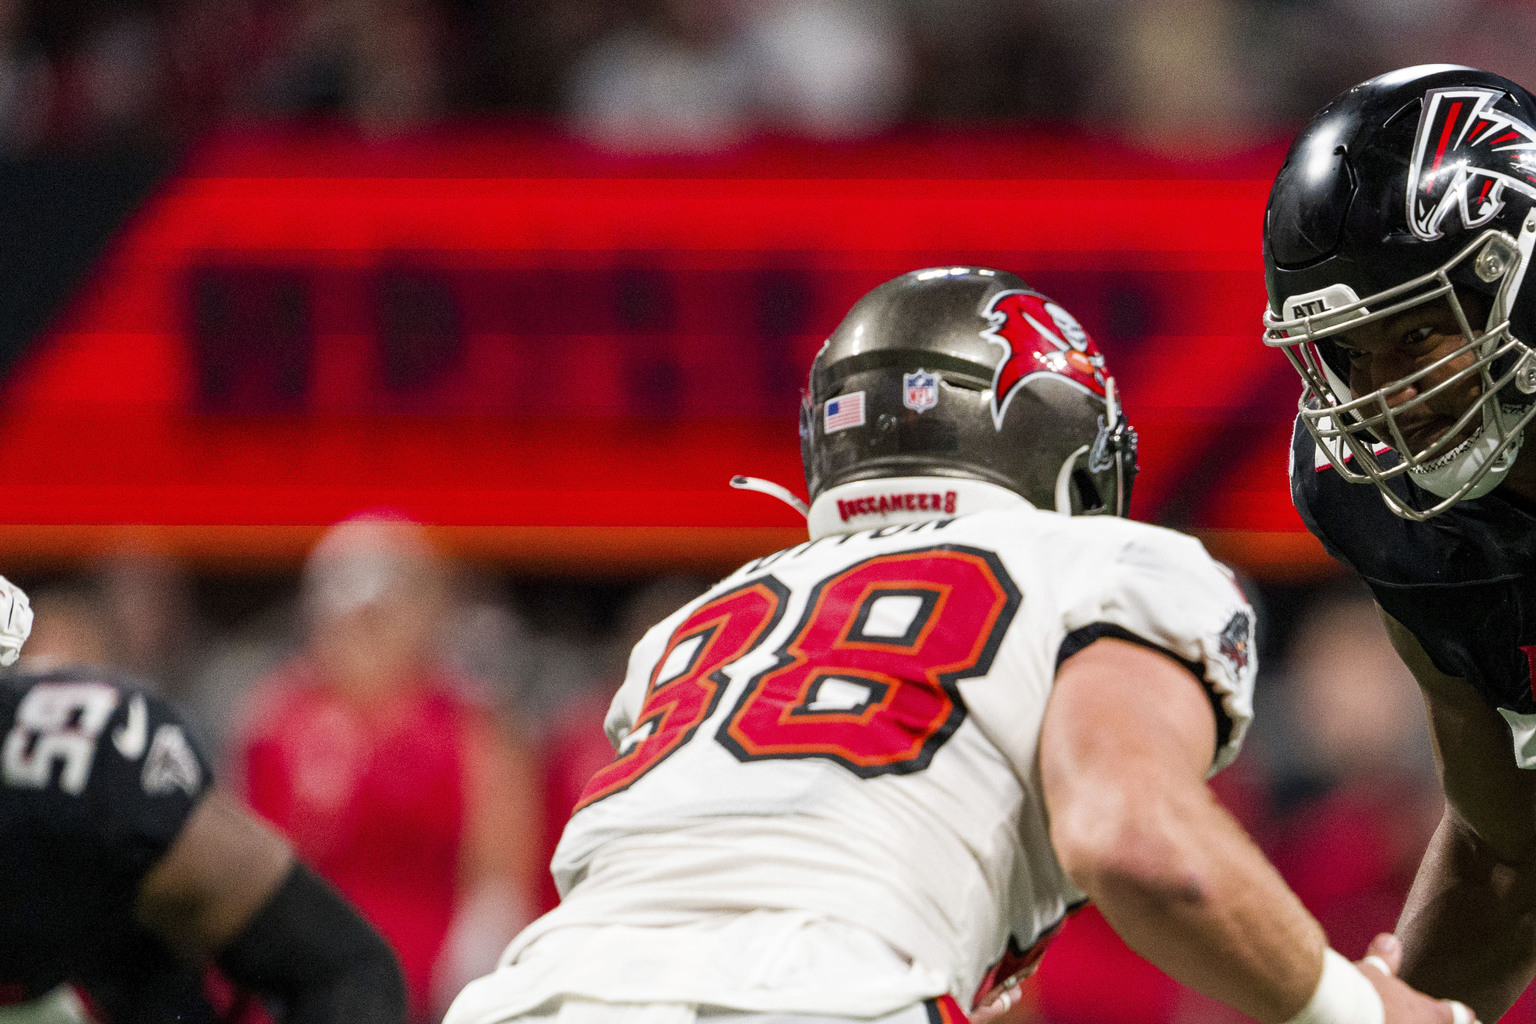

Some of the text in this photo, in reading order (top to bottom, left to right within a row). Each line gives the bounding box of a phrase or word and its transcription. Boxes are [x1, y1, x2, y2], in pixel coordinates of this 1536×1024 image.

[1292, 299, 1331, 319] ATL
[573, 543, 1023, 812] 88
[2, 682, 120, 796] 59
